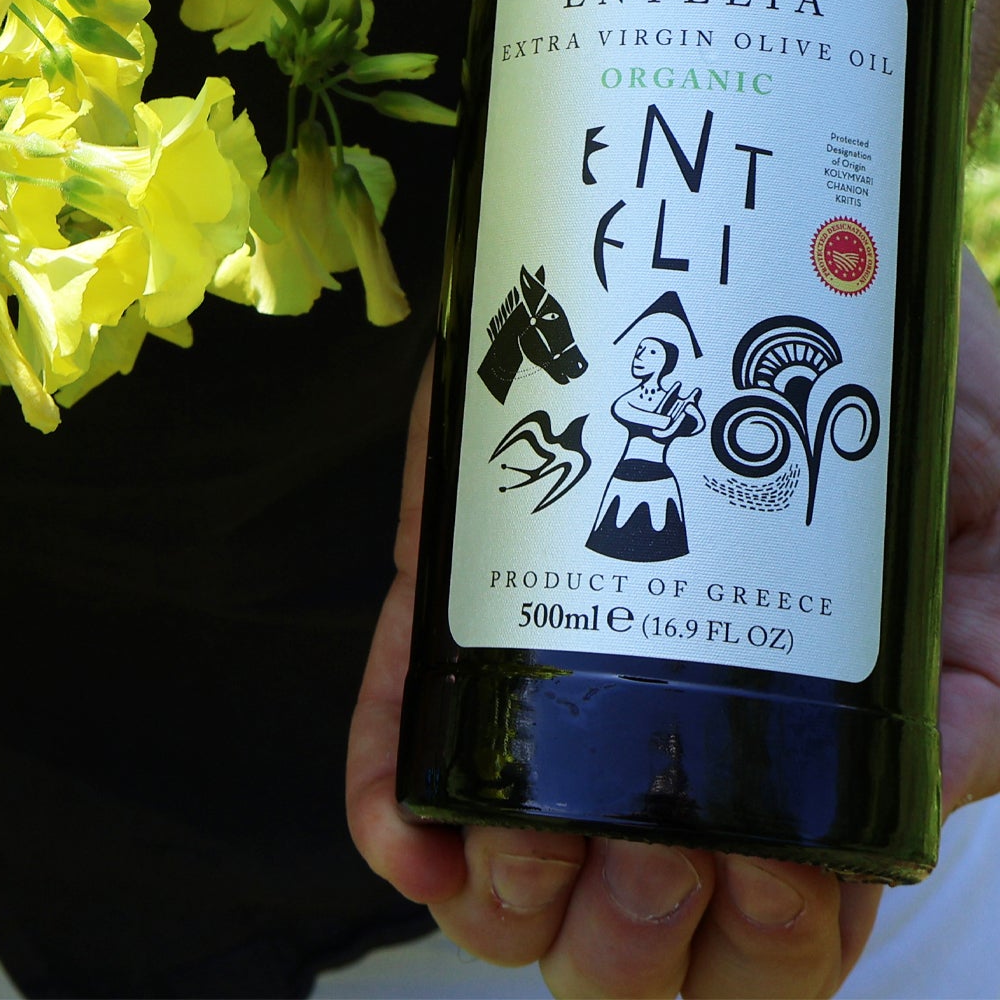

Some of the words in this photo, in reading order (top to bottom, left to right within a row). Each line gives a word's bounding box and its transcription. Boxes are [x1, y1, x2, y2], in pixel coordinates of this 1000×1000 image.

[501, 33, 581, 62] EXTRA
[598, 28, 714, 47] VIRGIN
[734, 32, 832, 61] OLIVE
[848, 49, 894, 76] OIL
[600, 66, 774, 96] ORGANIC
[830, 132, 870, 148] Protected
[826, 143, 872, 161] Designation
[831, 157, 841, 167] of
[841, 160, 866, 173] Origin
[824, 167, 874, 186] KOLYMVARI
[826, 180, 869, 197] CHANION
[835, 194, 862, 208] KRITIS
[816, 233, 829, 278] PROTECTED
[489, 570, 628, 594] PRODUCT
[647, 577, 688, 597] OF
[706, 583, 833, 616] GREECE
[517, 602, 599, 631] 500ml
[641, 614, 699, 641] (16.9
[706, 620, 744, 645] FL
[747, 625, 795, 655] OZ)
